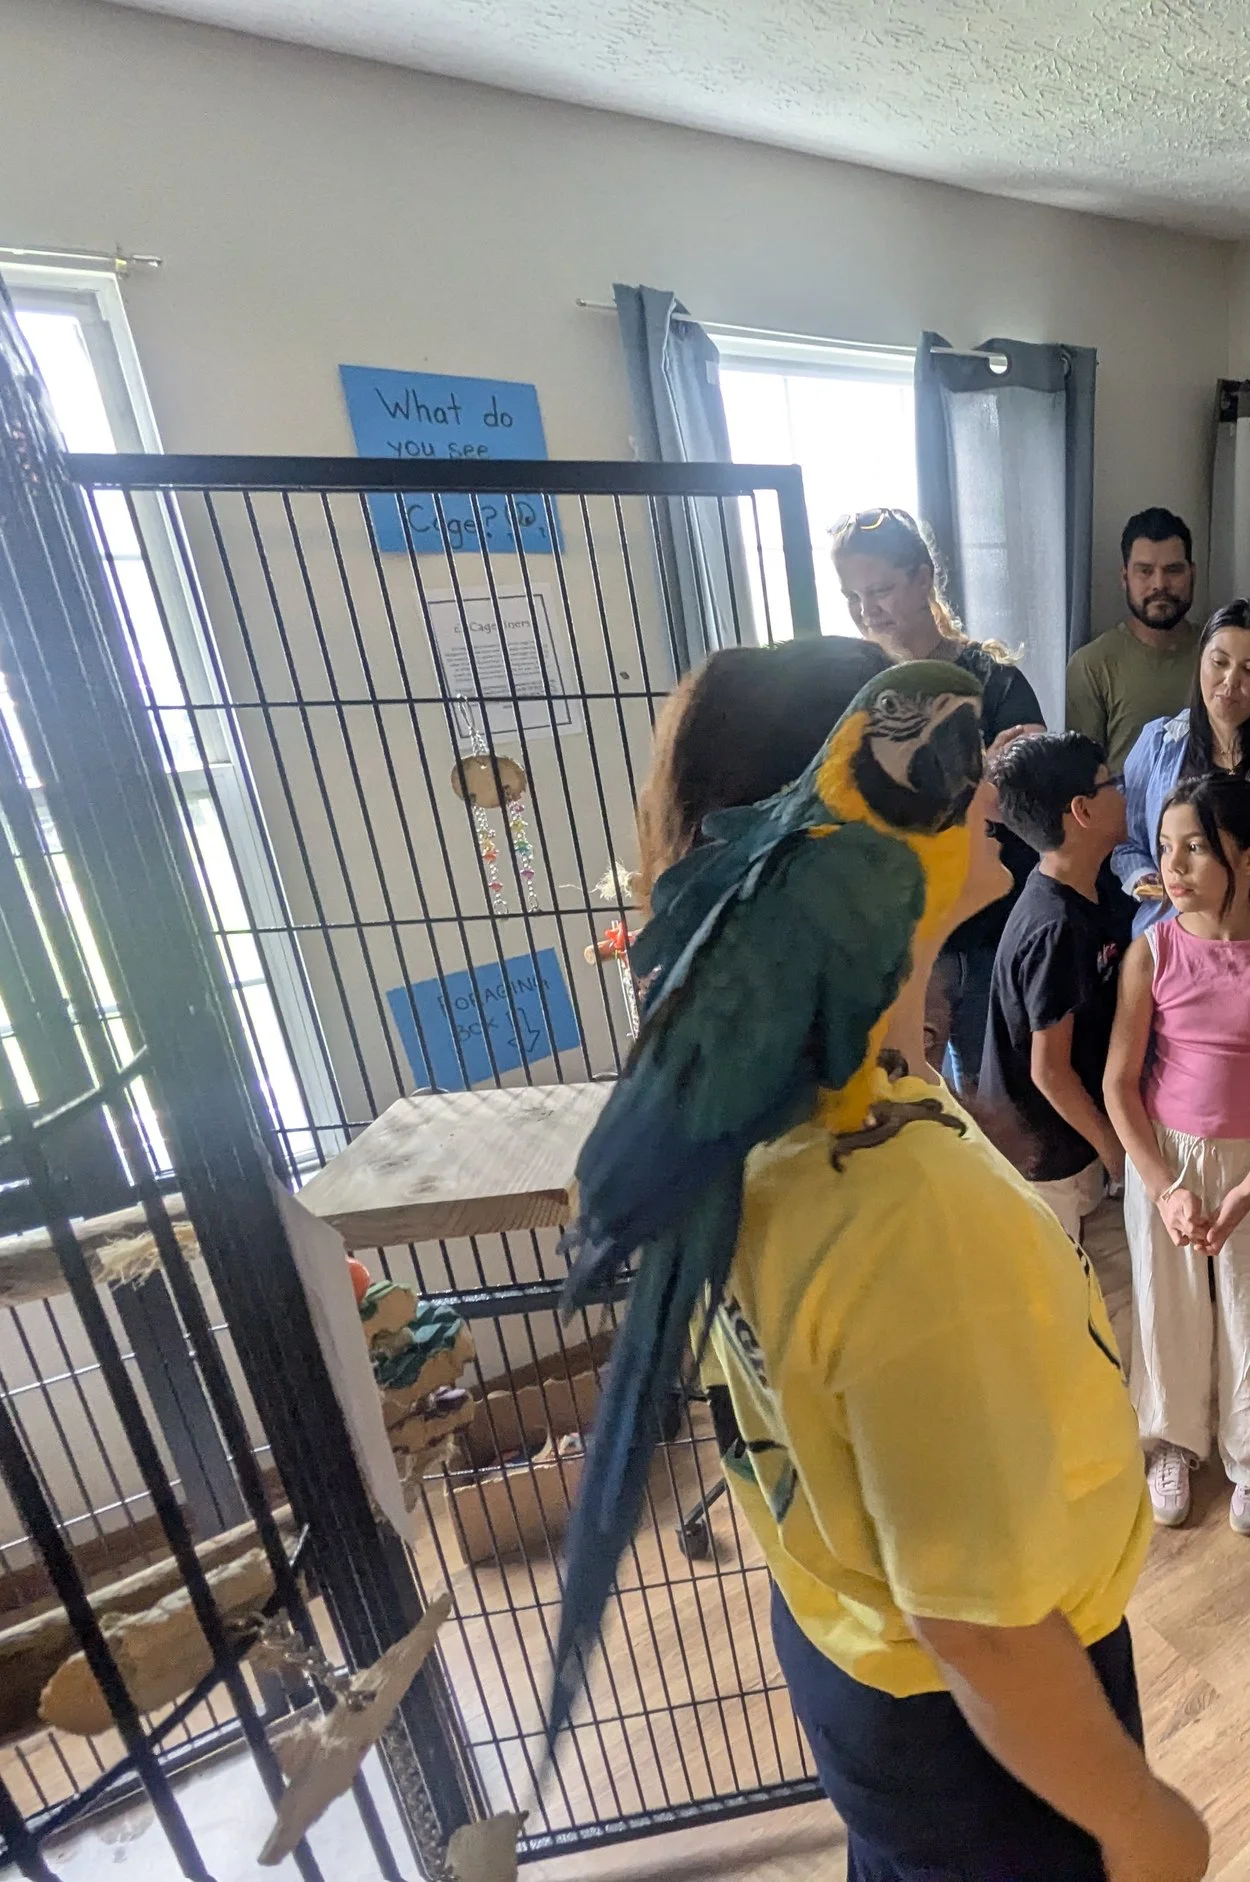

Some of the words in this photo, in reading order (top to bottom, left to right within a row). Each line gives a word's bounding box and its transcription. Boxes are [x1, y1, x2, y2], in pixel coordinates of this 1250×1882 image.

[374, 387, 462, 425] What
[483, 396, 513, 427] do
[386, 440, 435, 458] you
[448, 441, 489, 459] see
